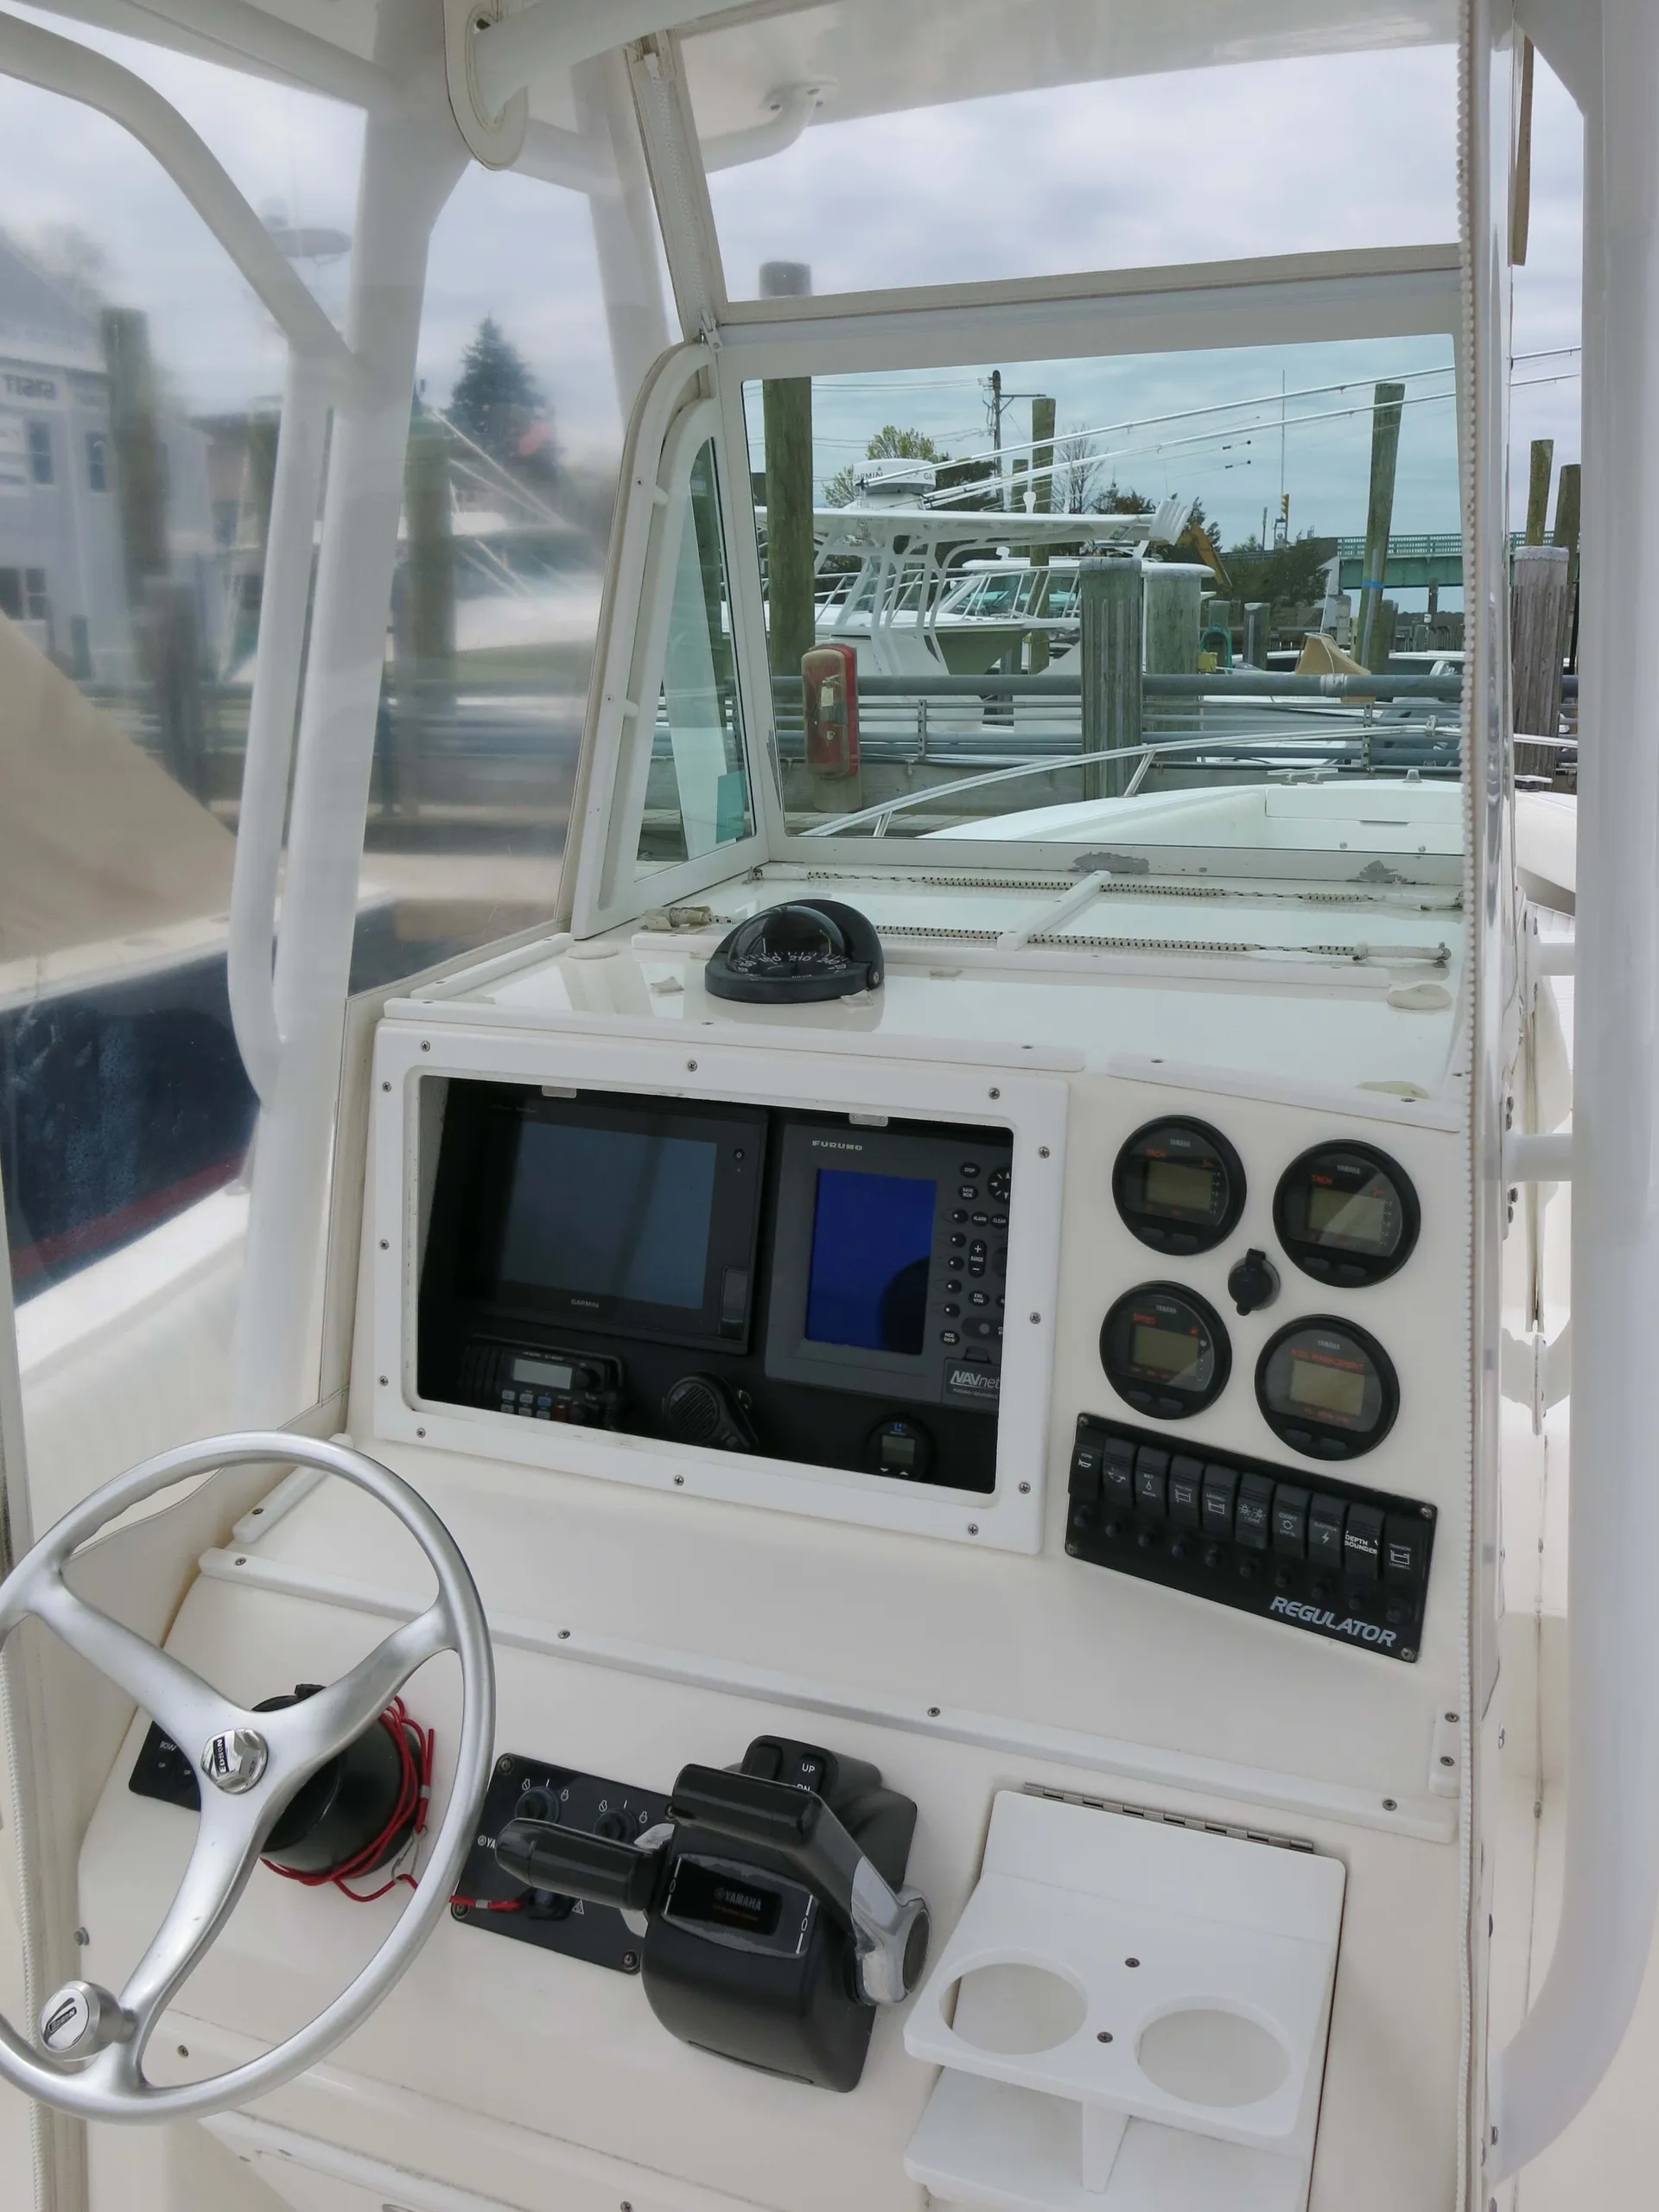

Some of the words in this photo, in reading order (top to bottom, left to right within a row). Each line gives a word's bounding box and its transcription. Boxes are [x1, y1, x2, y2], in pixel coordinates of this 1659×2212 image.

[812, 1141, 862, 1151] FURUNO
[1170, 1139, 1191, 1147] YAMAHA
[1338, 1165, 1360, 1174] YAMAHA
[570, 1298, 600, 1308] GARMIN
[1345, 1534, 1368, 1546] DEPTH
[1344, 1540, 1377, 1554] SOUNDER
[1269, 1596, 1396, 1647] REGULATOR
[216, 1738, 227, 1774] EDSON
[802, 1763, 816, 1773] UP
[726, 1890, 762, 1911] YAMAHA
